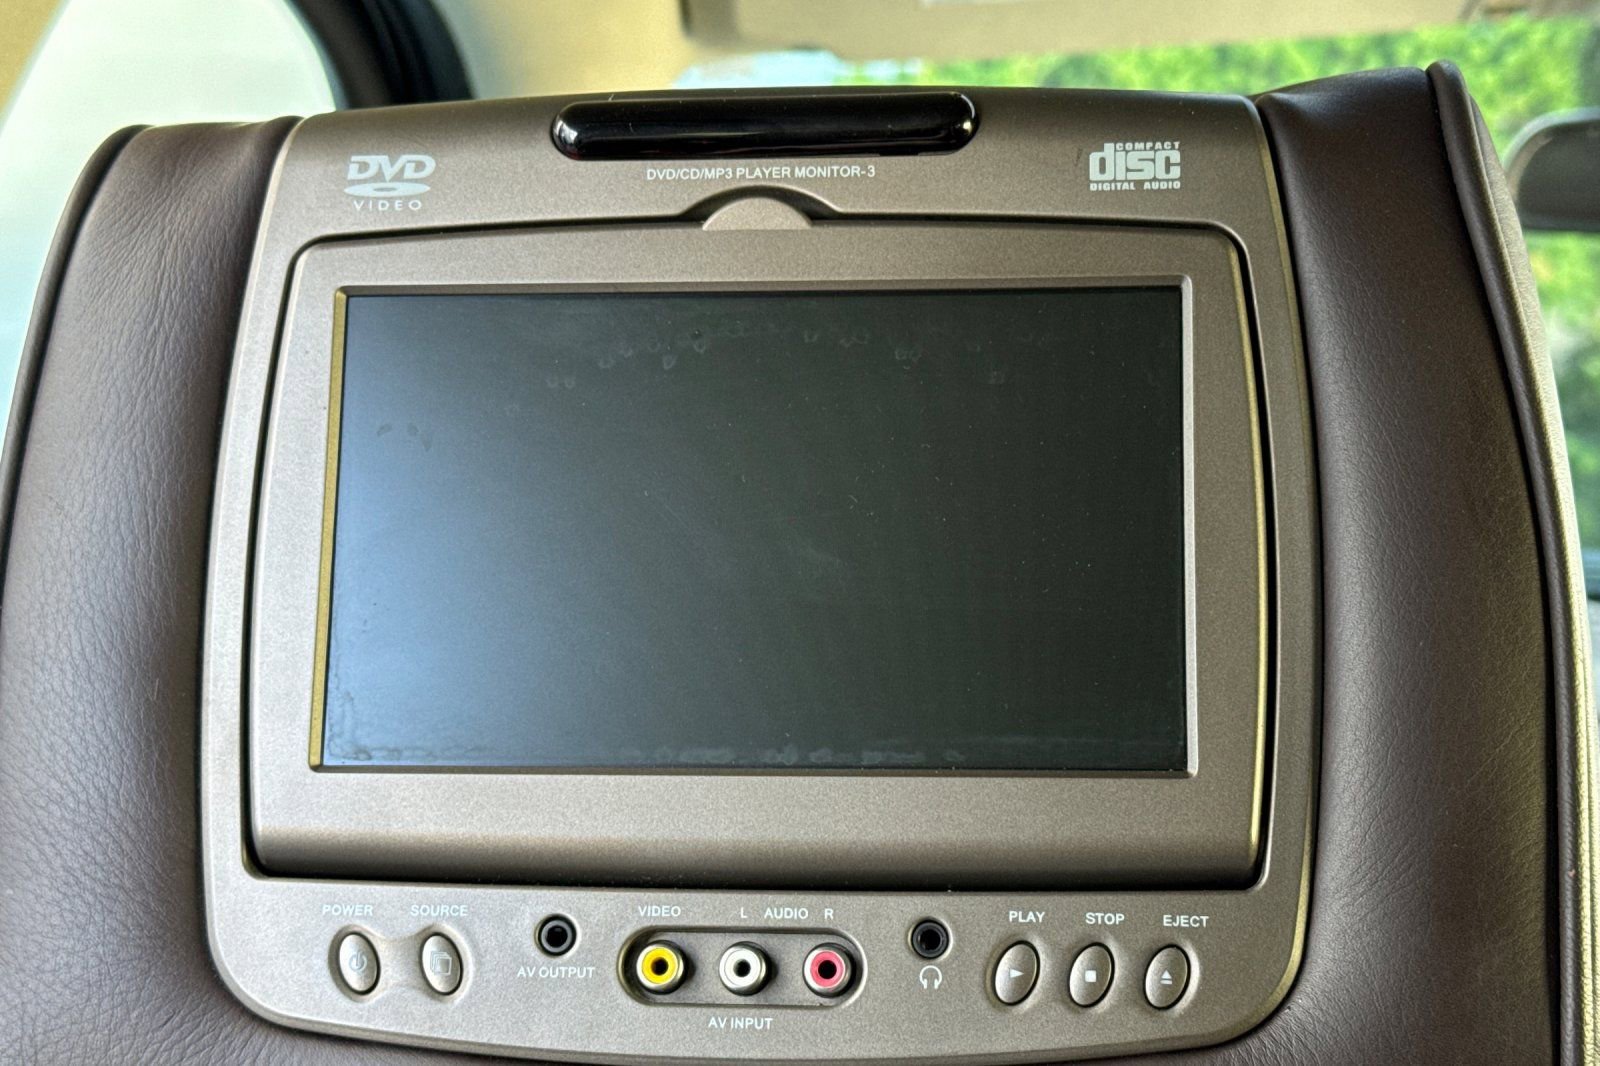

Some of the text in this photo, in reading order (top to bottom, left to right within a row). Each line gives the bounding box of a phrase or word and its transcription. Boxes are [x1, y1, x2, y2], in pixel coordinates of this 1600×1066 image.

[1115, 141, 1180, 151] COMPACT
[347, 154, 436, 182] DVD
[646, 165, 876, 180] DVD/CD/MP3 PLAYER MONITOR-3
[1089, 181, 1181, 192] DIGITAL AUDIO
[353, 199, 422, 211] VIDEO
[322, 904, 373, 917] POWER
[410, 904, 468, 917] SOURCE
[638, 905, 682, 917] VIDEO
[740, 908, 834, 920] L AUDIO R
[1009, 911, 1046, 924] PLAY
[1085, 912, 1126, 926] STOP
[1163, 915, 1210, 928] EJECT
[516, 966, 596, 979] AV OUTPUT
[708, 1017, 774, 1030] AV INPUT
